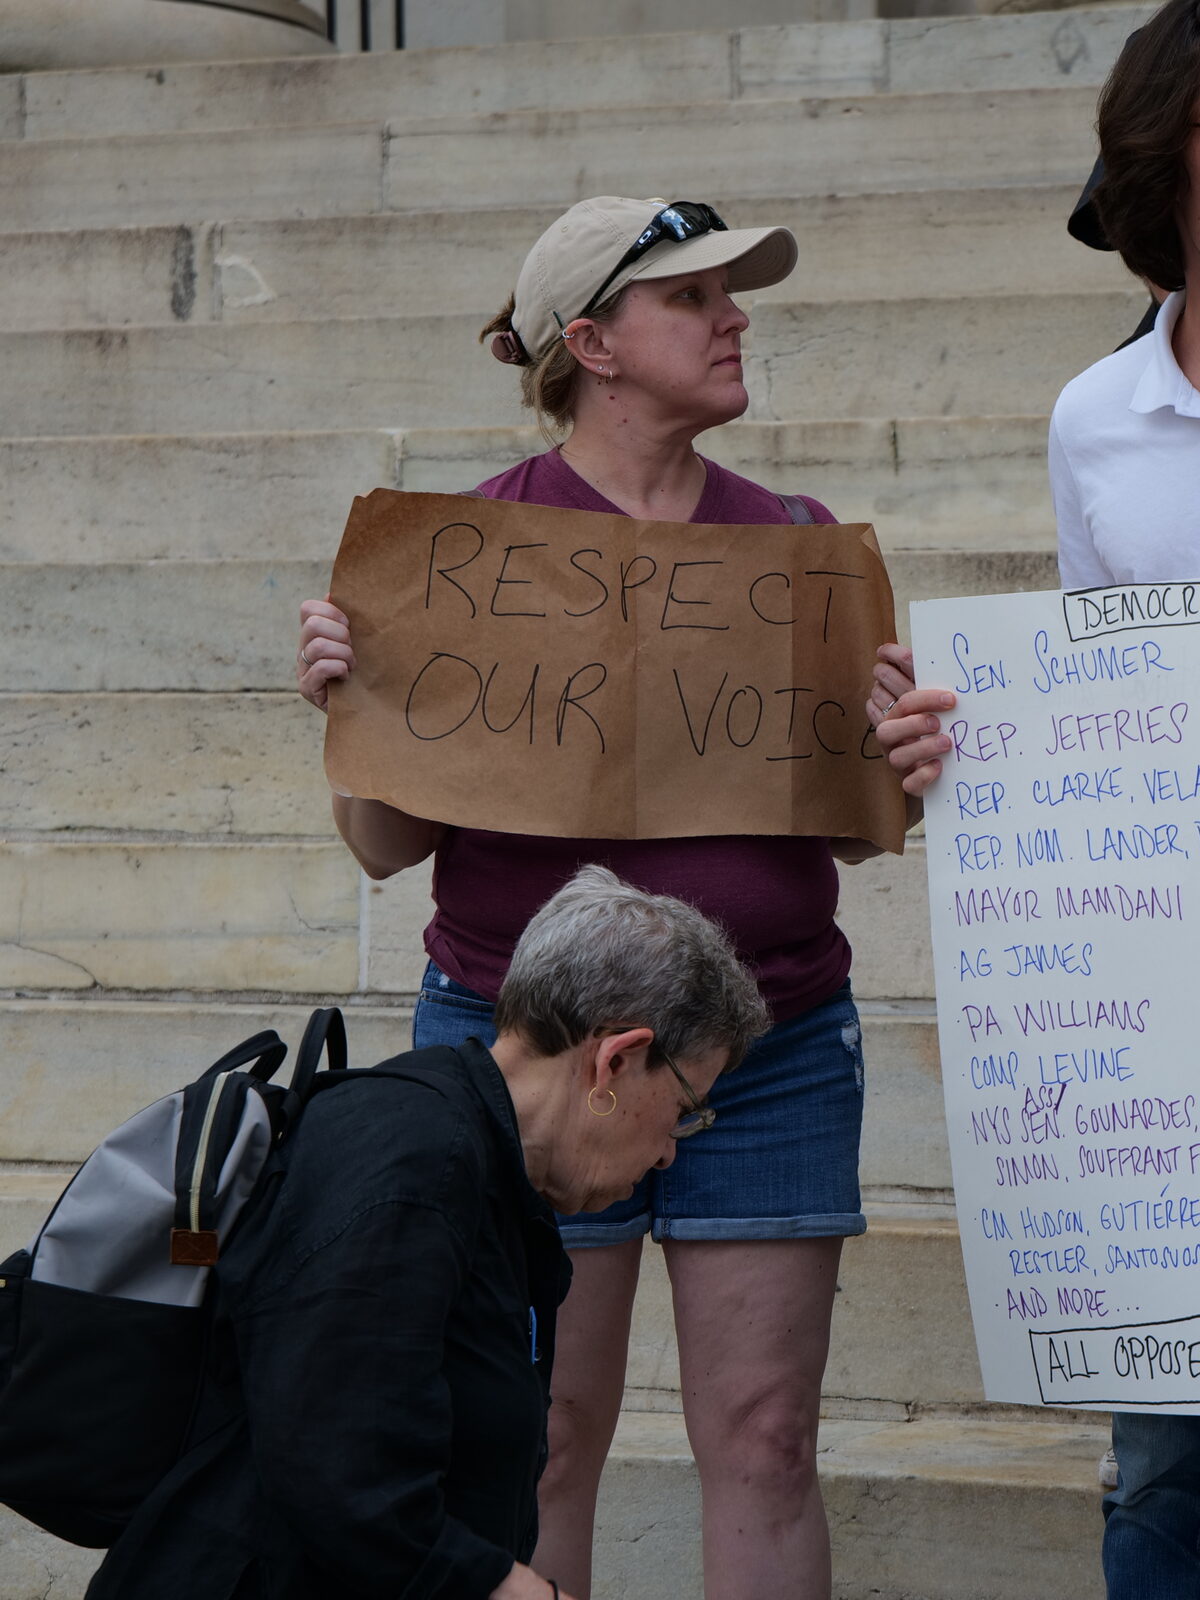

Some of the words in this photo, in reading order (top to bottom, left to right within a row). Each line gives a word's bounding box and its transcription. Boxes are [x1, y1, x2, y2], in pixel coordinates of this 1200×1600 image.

[425, 522, 866, 643] RESPECT
[405, 651, 607, 755] OUR
[950, 720, 1023, 763] REP.
[1046, 702, 1189, 756] JEFFRIES
[955, 781, 1012, 820] REP.
[1032, 767, 1135, 806] CLARKE,
[954, 833, 1005, 874] REP.
[1016, 828, 1074, 868] NOM.
[1086, 824, 1189, 861] LANDER,
[954, 886, 1043, 926] MAYOR
[1056, 884, 1183, 922] MAMDANI
[960, 948, 993, 982] AG
[1003, 943, 1094, 977] JAMES
[962, 1004, 1003, 1043] PA
[1013, 999, 1150, 1037] WILLIAMS
[1038, 1046, 1135, 1085] LEVINE
[971, 1105, 1012, 1146] NYS
[996, 1153, 1069, 1187] SIMON,
[1079, 1144, 1182, 1178] SOUFFRANT
[981, 1208, 1013, 1241] CM
[1020, 1206, 1091, 1239] HUDSON,
[1009, 1245, 1098, 1277] RESTLER,
[1007, 1287, 1047, 1321] AND
[1048, 1337, 1099, 1383] ALL
